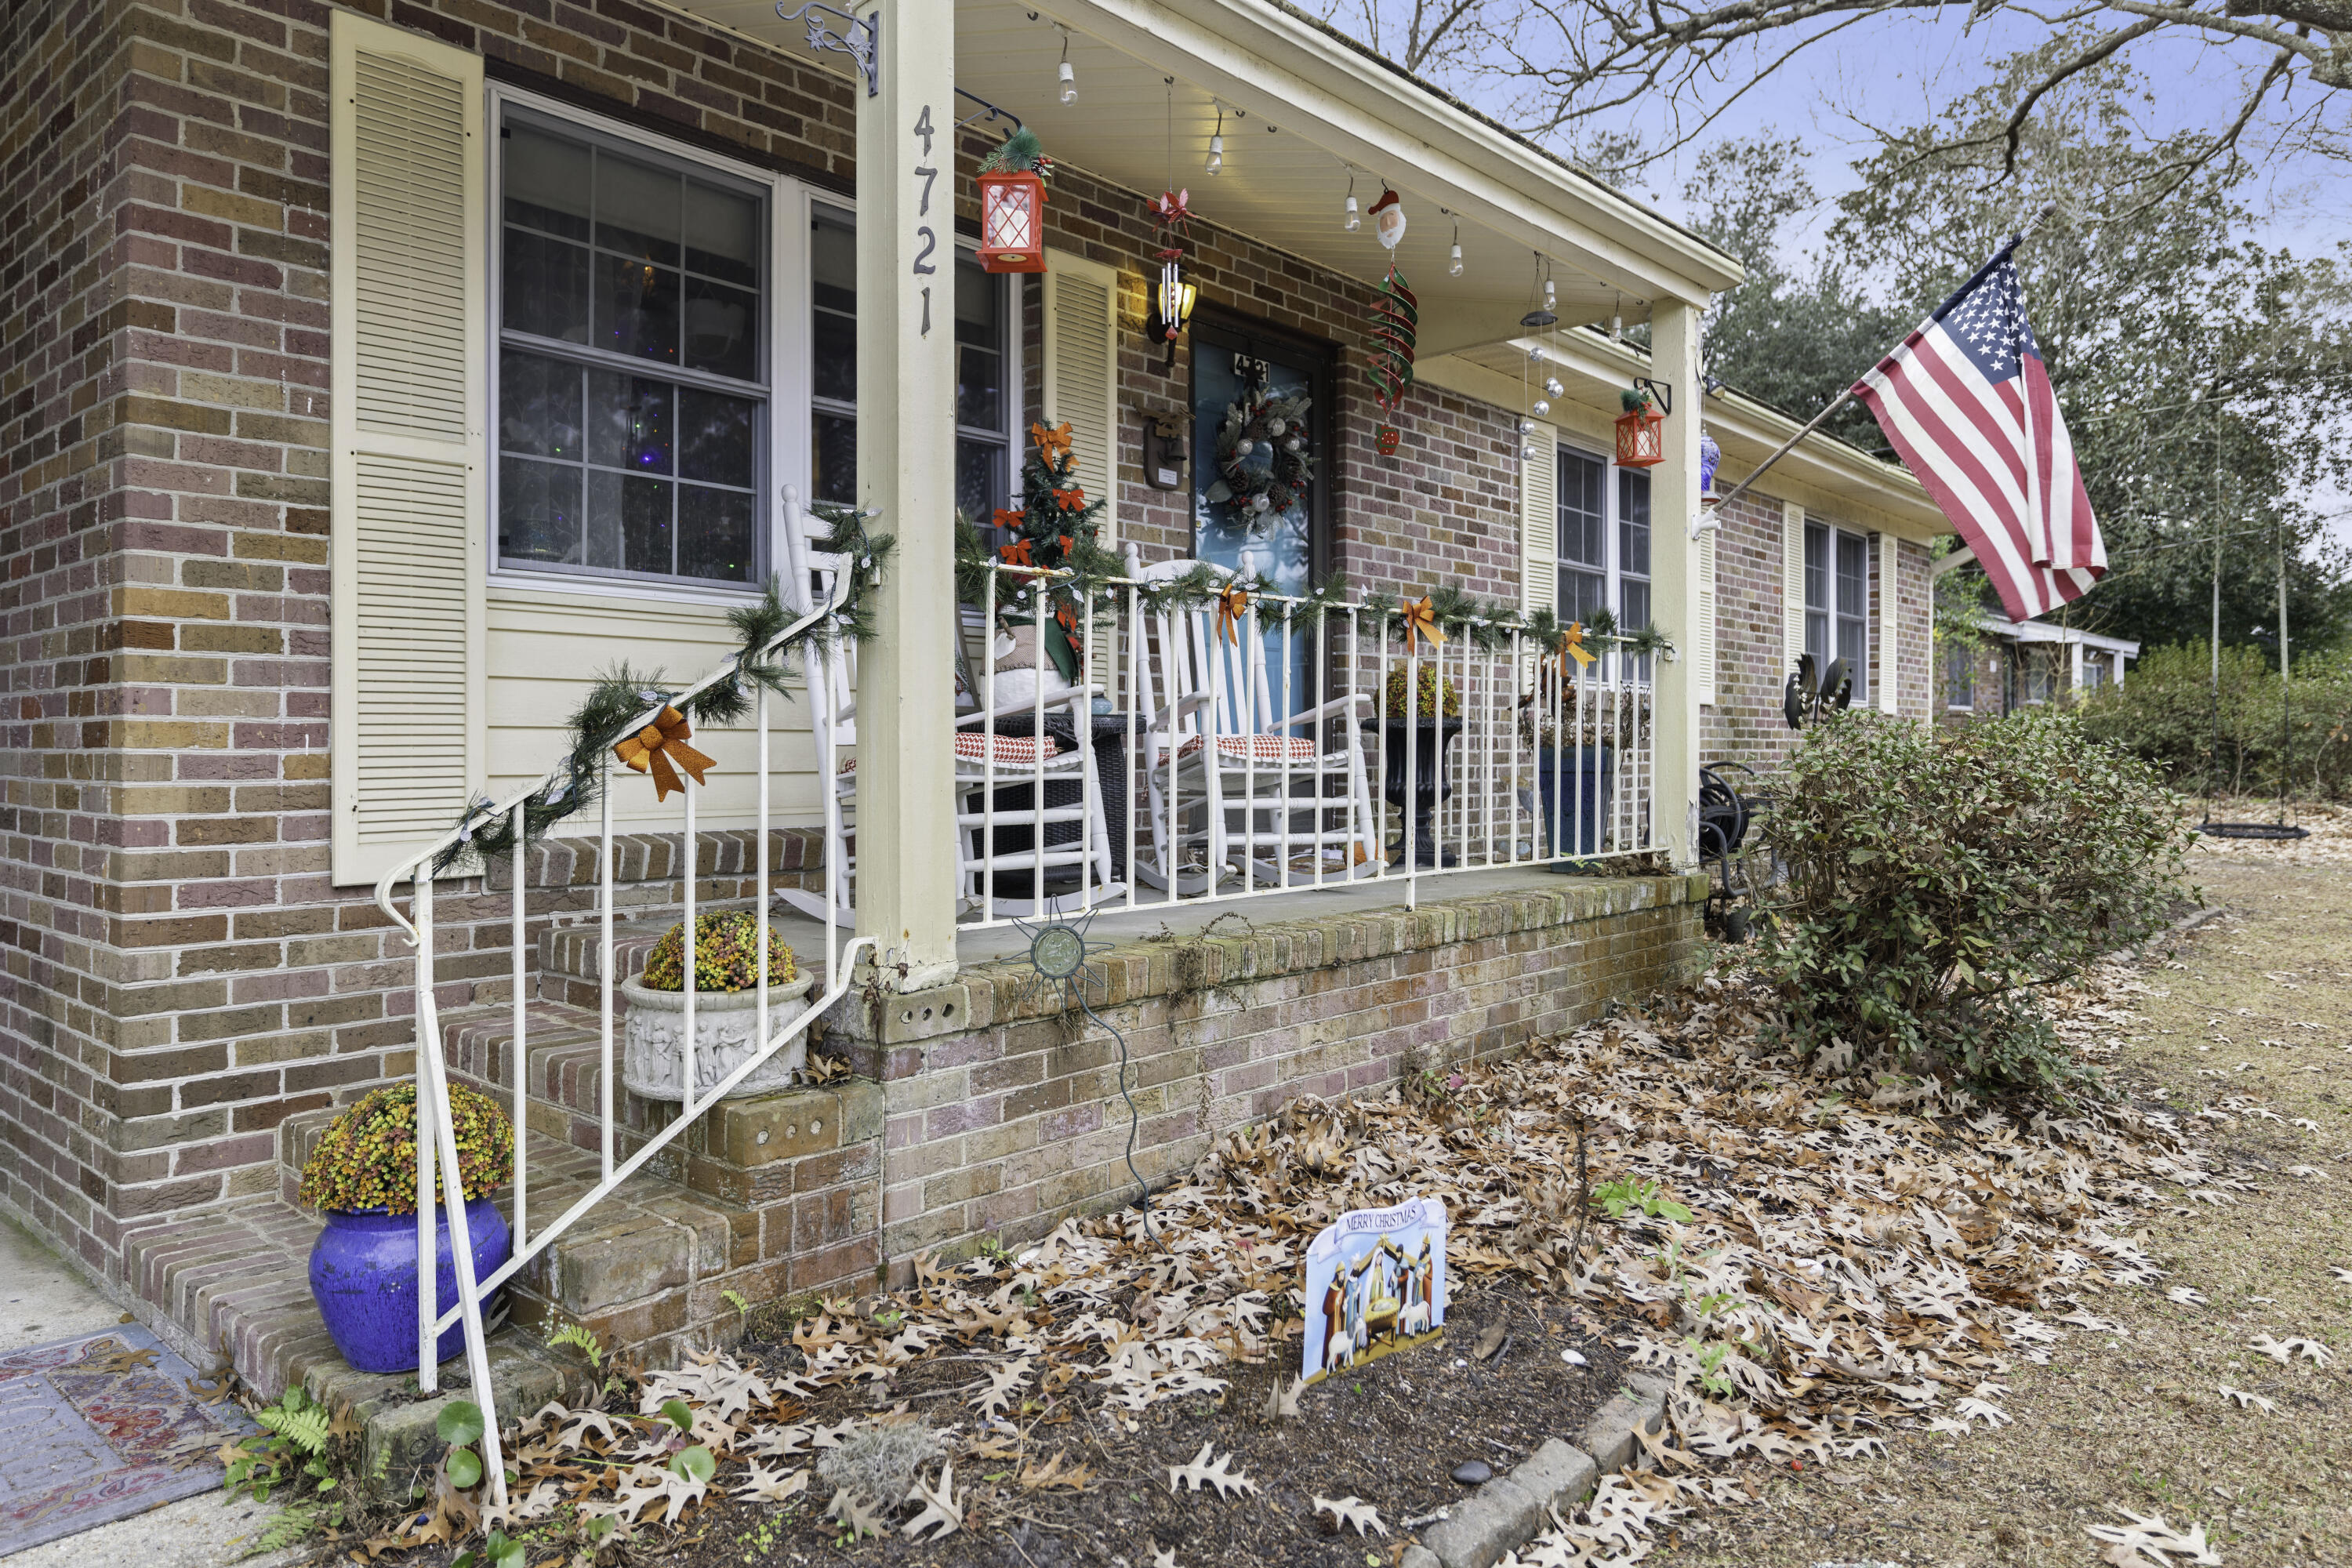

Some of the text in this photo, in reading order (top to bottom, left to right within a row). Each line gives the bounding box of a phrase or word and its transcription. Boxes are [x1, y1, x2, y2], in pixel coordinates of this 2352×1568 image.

[913, 104, 938, 336] 4721
[1346, 1206, 1416, 1231] MERRY CHRISTMAS
